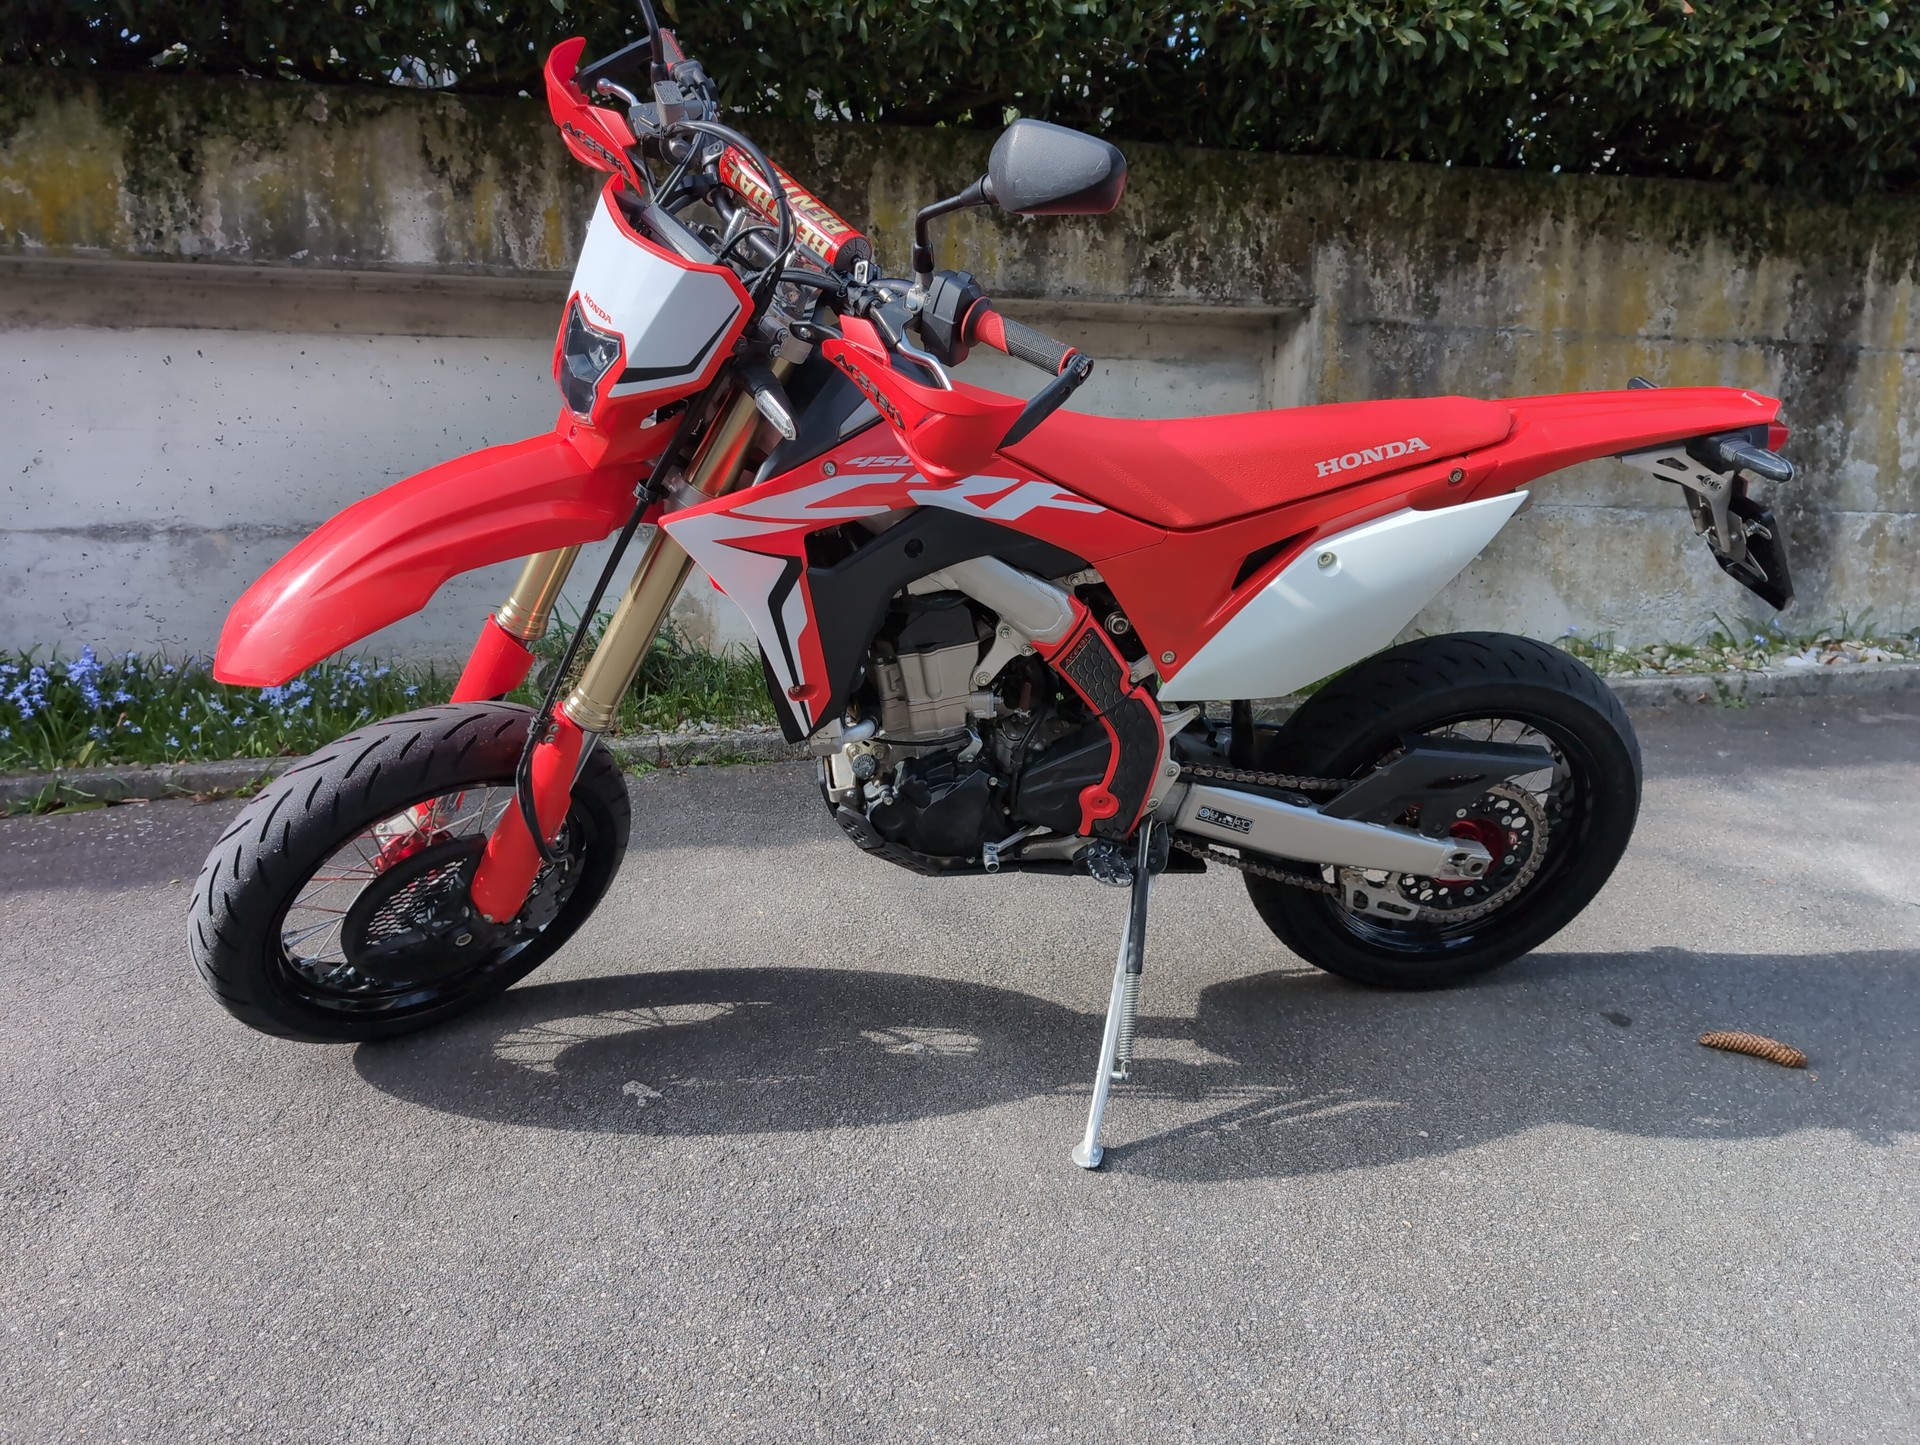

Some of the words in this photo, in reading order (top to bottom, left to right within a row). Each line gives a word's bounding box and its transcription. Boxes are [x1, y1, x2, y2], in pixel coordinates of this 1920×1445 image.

[583, 292, 613, 325] HONDA
[833, 353, 906, 431] ACERBIS
[1313, 436, 1432, 478] HONDA
[1065, 632, 1092, 665] ACERBIS
